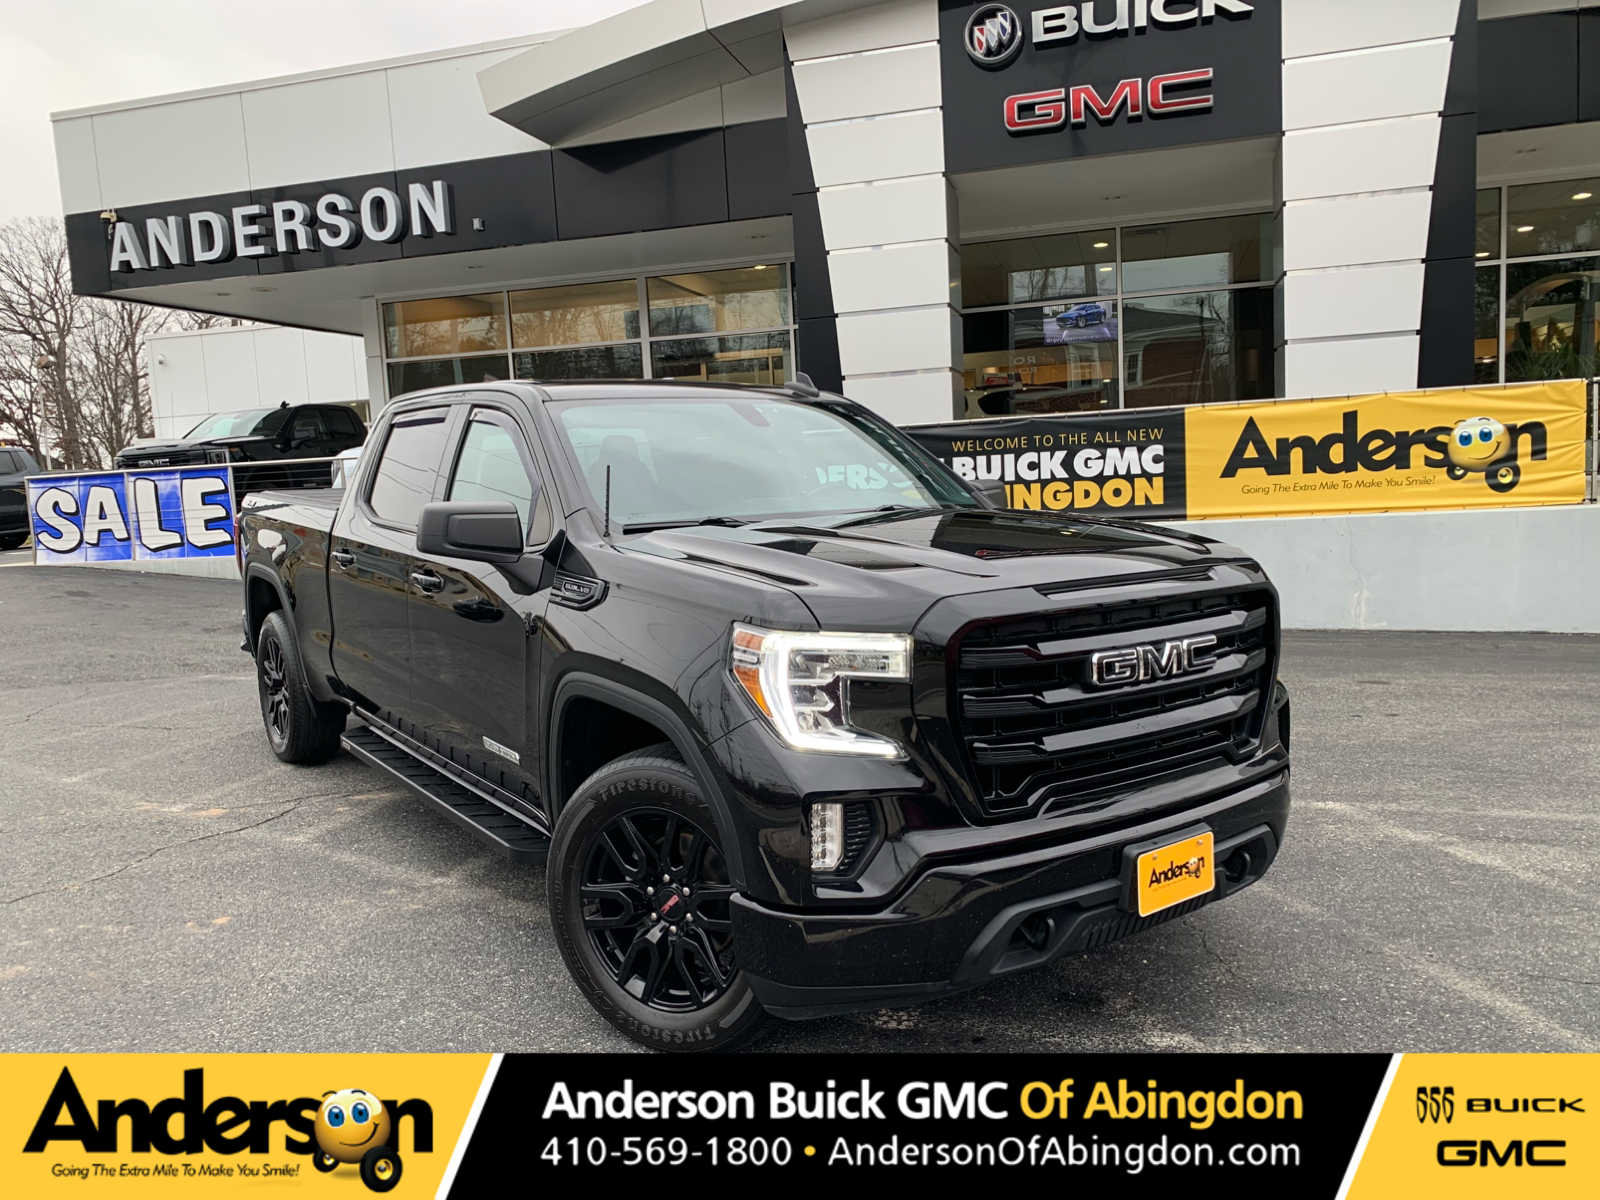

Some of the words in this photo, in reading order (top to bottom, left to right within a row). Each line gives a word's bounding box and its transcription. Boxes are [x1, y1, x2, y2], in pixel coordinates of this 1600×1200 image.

[1003, 67, 1214, 131] GMC
[110, 180, 452, 272] ANDERSON
[951, 439, 1028, 452] WELCOME
[1033, 435, 1054, 447] TO
[1058, 432, 1088, 445] THE
[1094, 430, 1121, 443] ALL
[1127, 427, 1165, 441] NEW
[952, 449, 1070, 482] BUICK
[1073, 444, 1165, 482] GMC
[1241, 484, 1270, 495] Going
[1272, 482, 1291, 493] The
[1292, 481, 1317, 492] Extra
[1319, 480, 1340, 490] Mile
[1342, 479, 1353, 490] To
[1355, 478, 1384, 489] Make
[1386, 478, 1404, 488] You
[1405, 476, 1436, 487] Smile!
[35, 476, 235, 554] SALE
[1091, 634, 1217, 685] GMC
